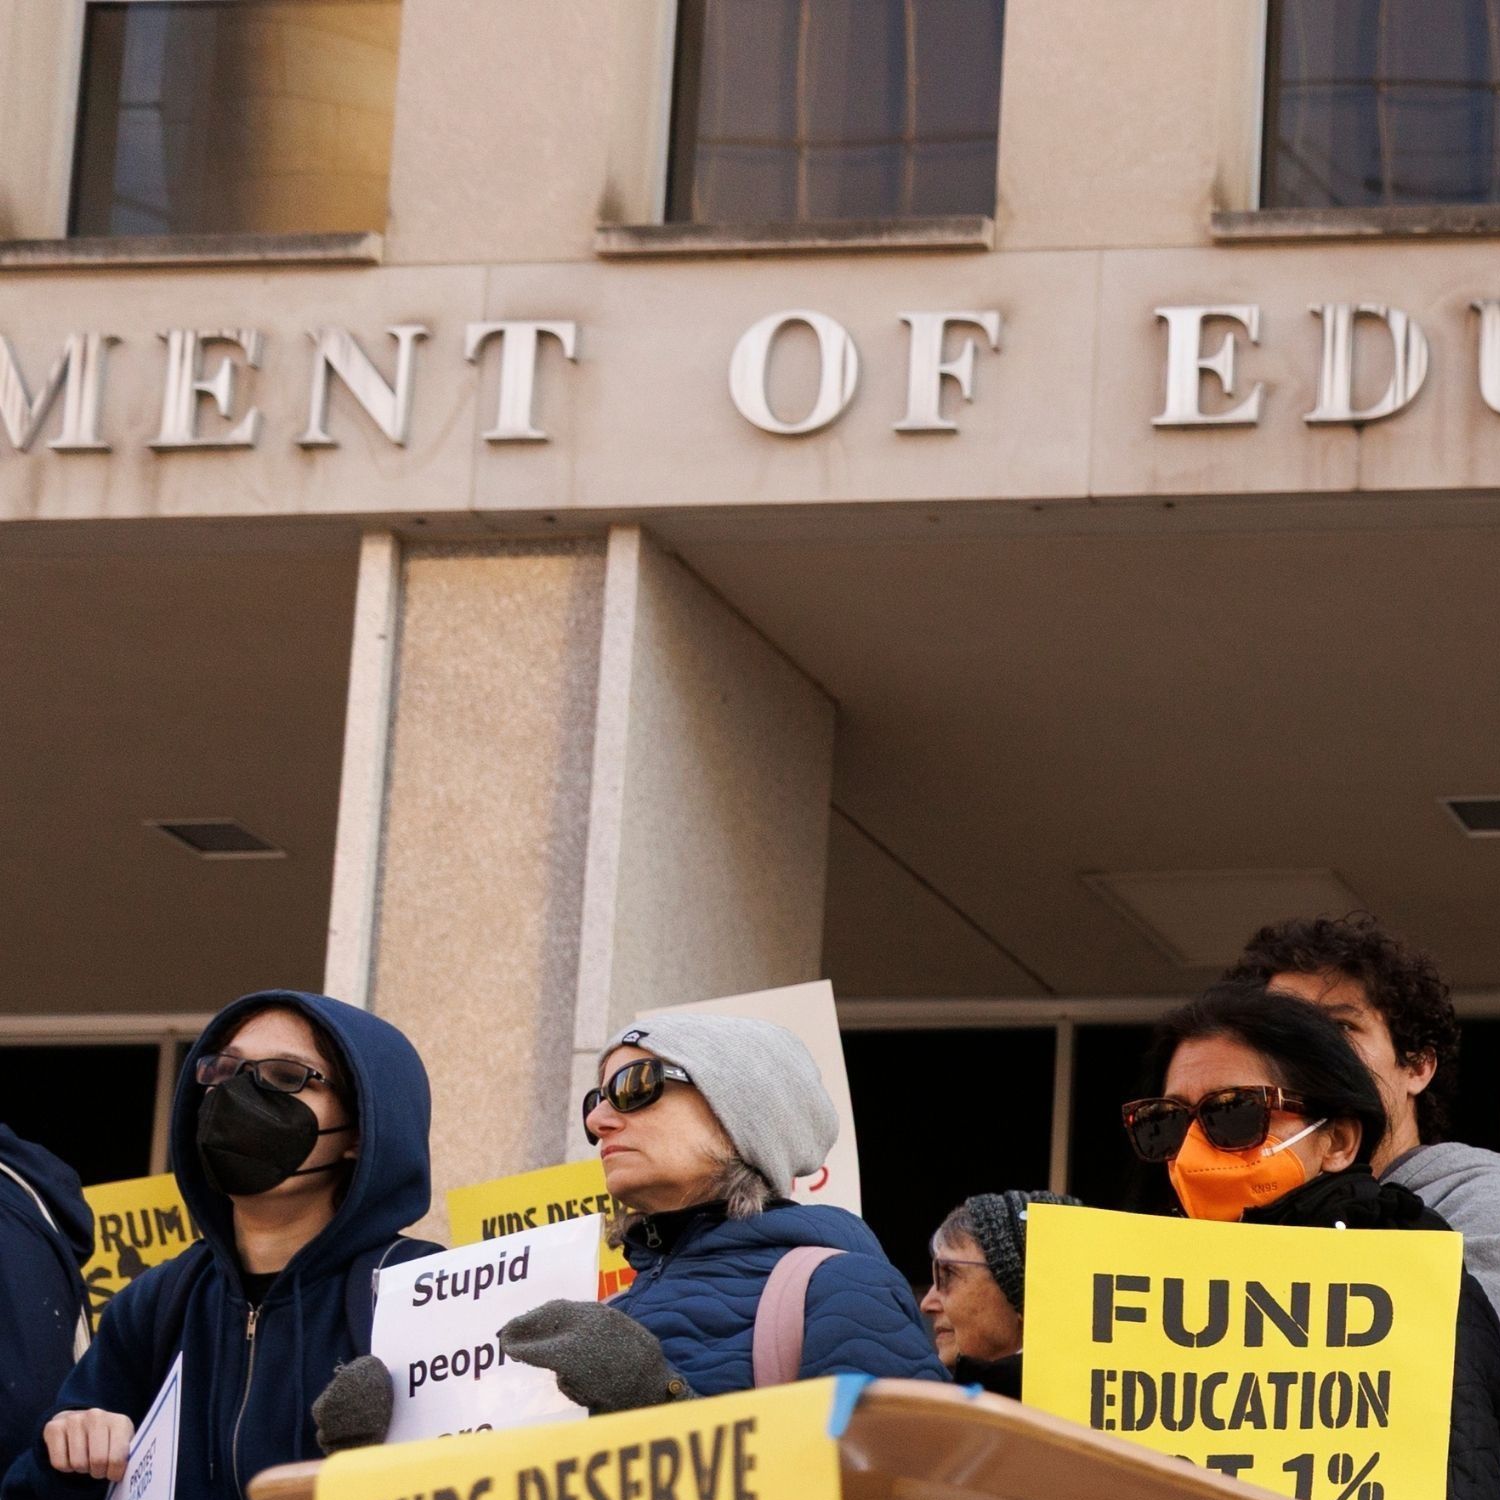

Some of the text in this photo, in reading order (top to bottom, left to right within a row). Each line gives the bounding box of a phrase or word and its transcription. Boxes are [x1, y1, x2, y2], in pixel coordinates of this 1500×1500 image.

[0, 320, 577, 454] MENT
[728, 307, 1001, 436] OF
[1251, 1182, 1279, 1195] KN95
[99, 1205, 199, 1253] RUM
[412, 1245, 531, 1308] Stupid
[1092, 1273, 1394, 1349] FUND
[408, 1334, 512, 1399] peopl
[1090, 1369, 1391, 1433] EDUCATION
